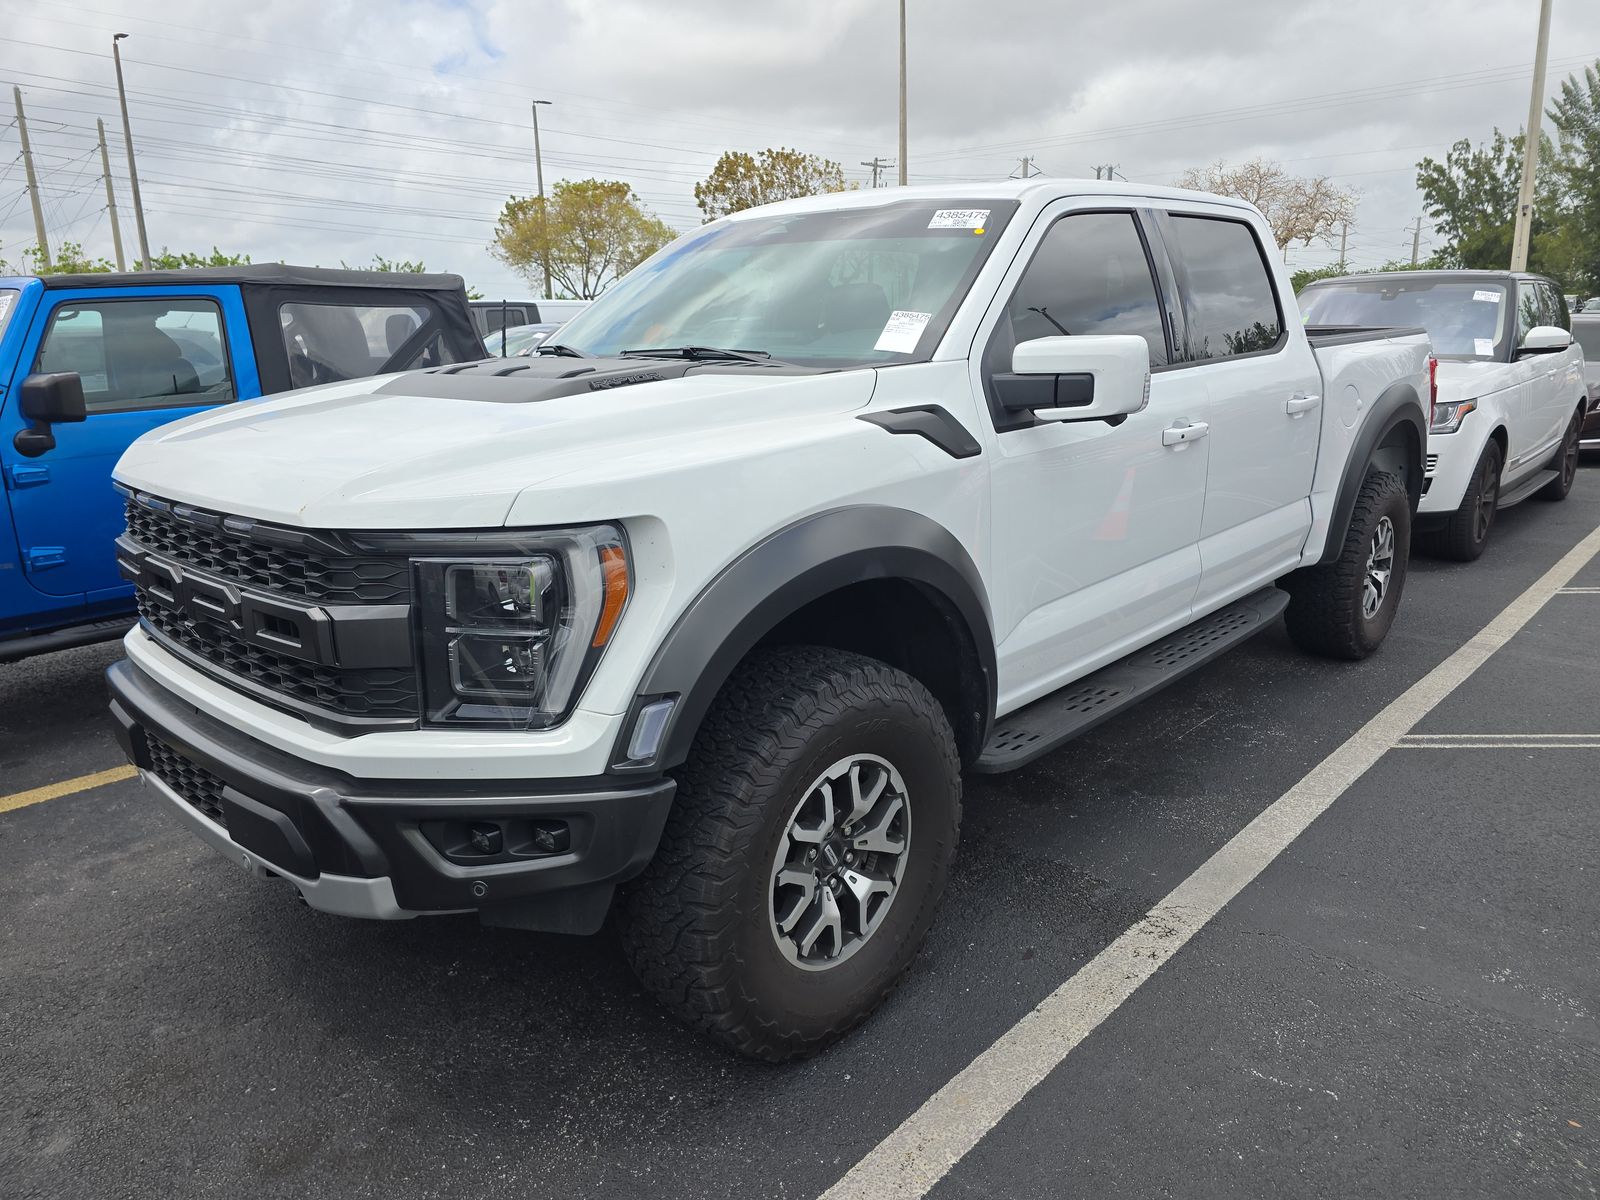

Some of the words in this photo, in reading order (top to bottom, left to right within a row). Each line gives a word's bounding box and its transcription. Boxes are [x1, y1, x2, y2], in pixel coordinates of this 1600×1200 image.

[936, 211, 988, 219] 4385475
[893, 311, 930, 320] 4385475
[588, 372, 665, 391] RAPTOR
